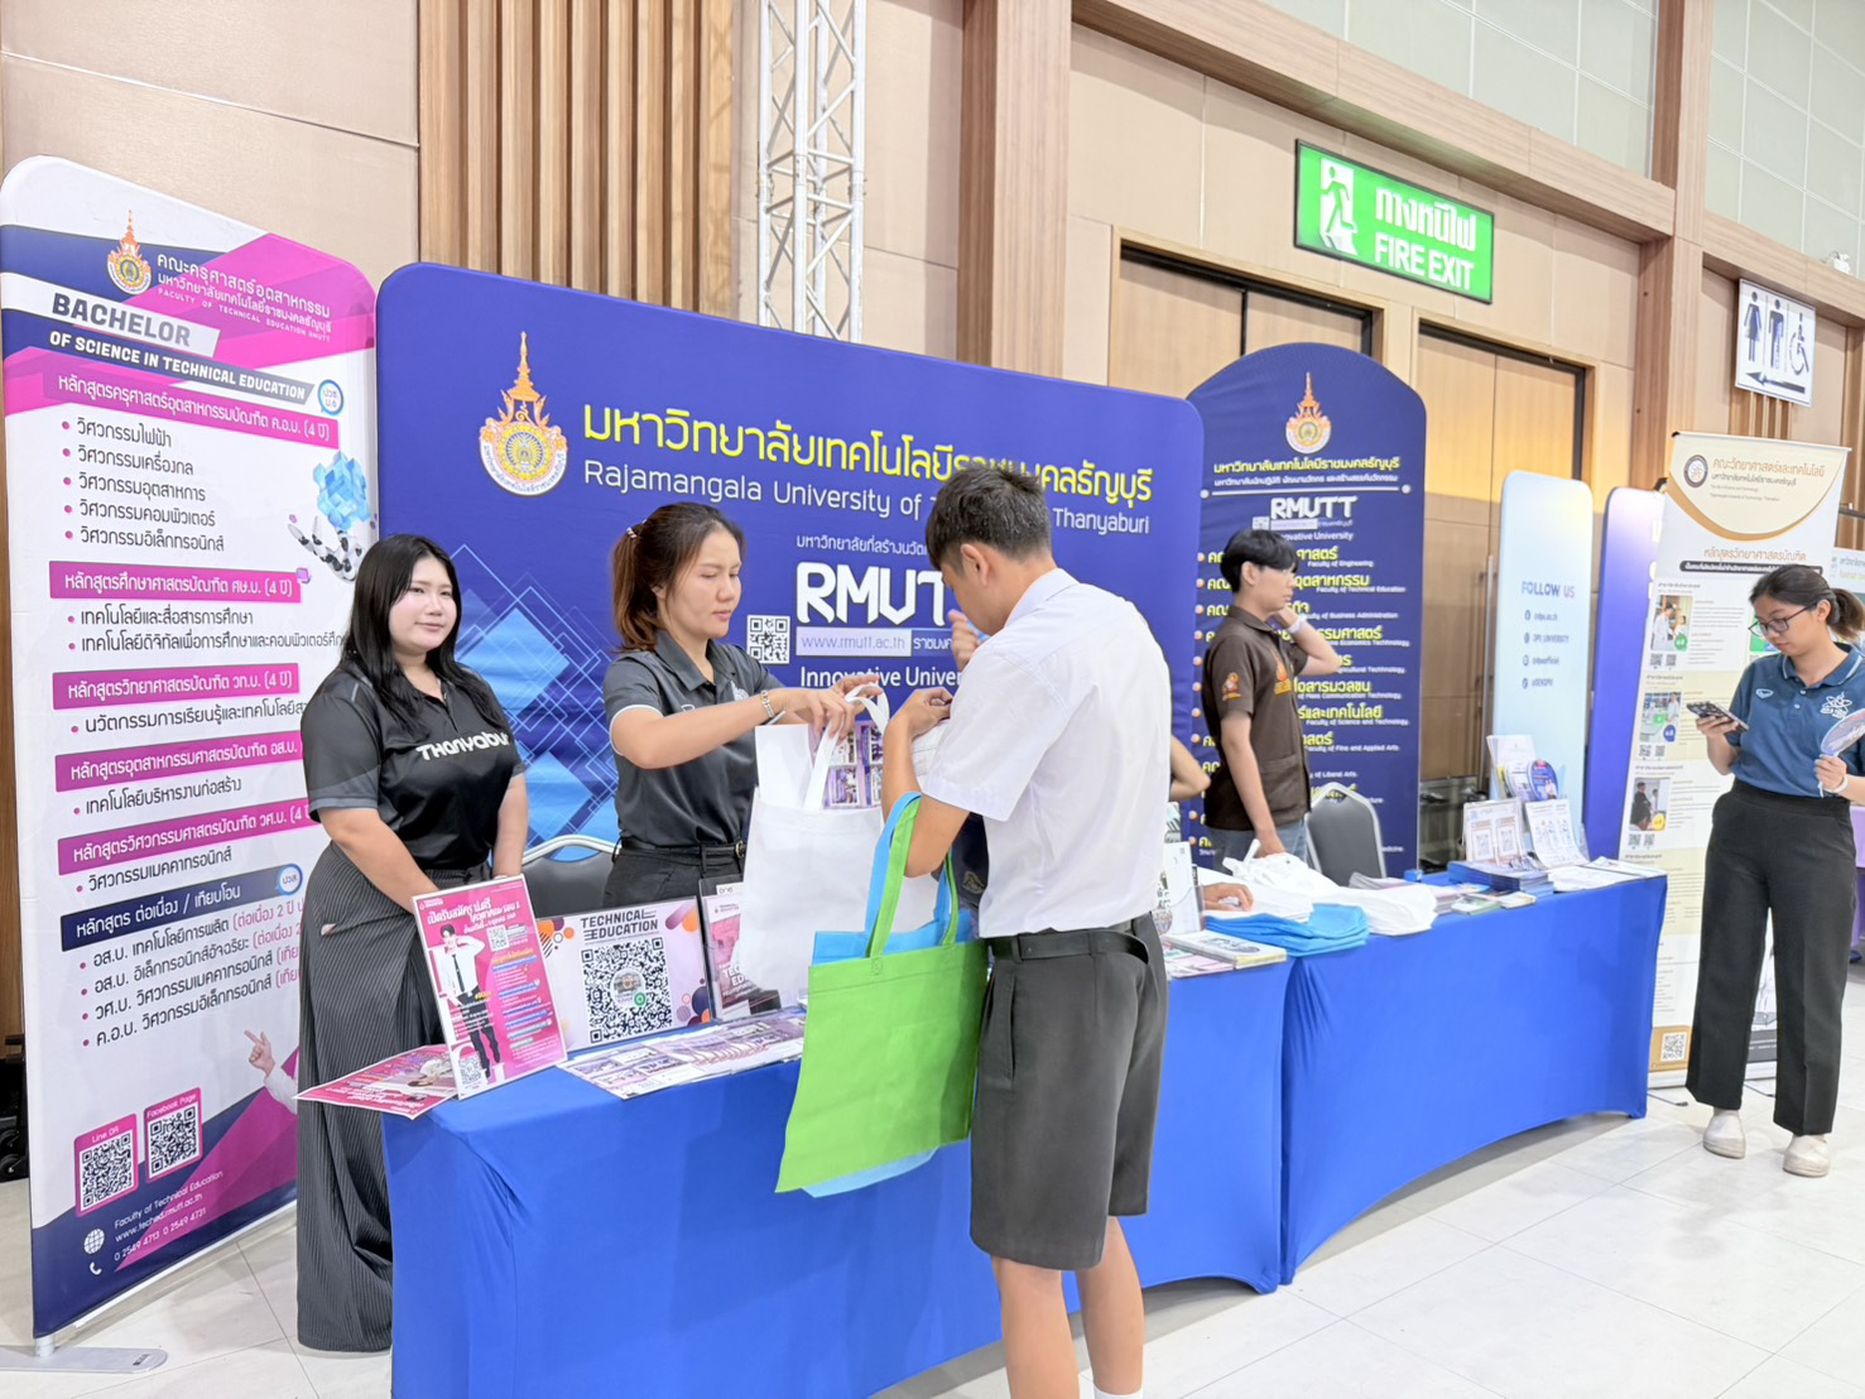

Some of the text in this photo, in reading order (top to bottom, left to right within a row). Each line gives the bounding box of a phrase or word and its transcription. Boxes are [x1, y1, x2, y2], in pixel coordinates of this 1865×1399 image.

[1375, 232, 1475, 290] FIRE EXIT
[158, 253, 330, 318] คณะครุศาสตร์อุตสาหกรรม
[51, 293, 191, 348] BACHELOR
[158, 288, 196, 304] FACULTY
[202, 301, 213, 309] OF
[219, 305, 261, 324] TECHNICAL
[50, 331, 305, 399] OF SCIENCE IN TECHNICAL EDUCATION
[77, 417, 172, 448] วิศวกรรมไฟฟ้า
[78, 444, 194, 476] วิศวกรรมเครื่องกล
[79, 472, 206, 502] วิศวกรรมอุตสาหการ
[584, 459, 763, 503] Rajamangala
[773, 480, 890, 519] University
[900, 496, 924, 521] of
[80, 499, 216, 527] วิศวกรรมคอมพิวเตอร์
[1052, 507, 1151, 536] Thanyaburi
[1270, 495, 1358, 520] RMUTT
[80, 526, 224, 552] วิศวกรรมอิเล็กทรอนิกส์
[1314, 531, 1354, 542] University
[65, 571, 229, 595] หลักสูตรศึกษาศาสตรบัณฑิต
[796, 561, 946, 628] RMUT
[1521, 580, 1575, 598] FOLLOW US
[81, 604, 254, 626] เทคโนโลยีและสื่อสารการศึกษา
[82, 629, 343, 652] เทคโนโลยีดิจิทัลเพื่อการศึกษาและคอมพิวเตอร์ศึก
[801, 635, 906, 651] www.rmutt.ac.th
[68, 676, 230, 702] หลักสูตรวิทยาศาสตรบัณฑิต
[800, 666, 962, 688] Innove Univer
[70, 741, 268, 782] หลักสูตรอุตสาหกรรมศาสตรบัณฑิต
[86, 778, 243, 815] เทคโนโลยีบริหารงานก่อสร้าง
[73, 816, 256, 863] หลักสูตรวิศวกรรมศาสตรบัณฑิต
[88, 845, 233, 893] วิศวกรรมเมคคาทรอนิกส์
[76, 915, 131, 938] หลักสูตร
[135, 900, 178, 923] ต่อเนื่อง
[194, 883, 241, 909] เทียบโอน
[580, 909, 656, 929] TECHNICAL
[93, 949, 128, 968] อส.บ.
[132, 918, 230, 957] เทคโนโลยีการผลิต
[583, 919, 659, 942] EDUCATION
[94, 974, 129, 995] อส.บ.
[133, 934, 249, 982] อิเล็กทรอนิกส์อัจฉริยะ
[95, 998, 131, 1022] วศ.บ.
[136, 949, 273, 1001] วิศวกรรมเมคคาทรอนิกส์
[97, 1025, 137, 1047] ค.อ.บ.
[142, 972, 272, 1030] วิศวกรรมอิเล็กทรอนิกส์
[114, 1170, 224, 1230] Faculty of Technical Education
